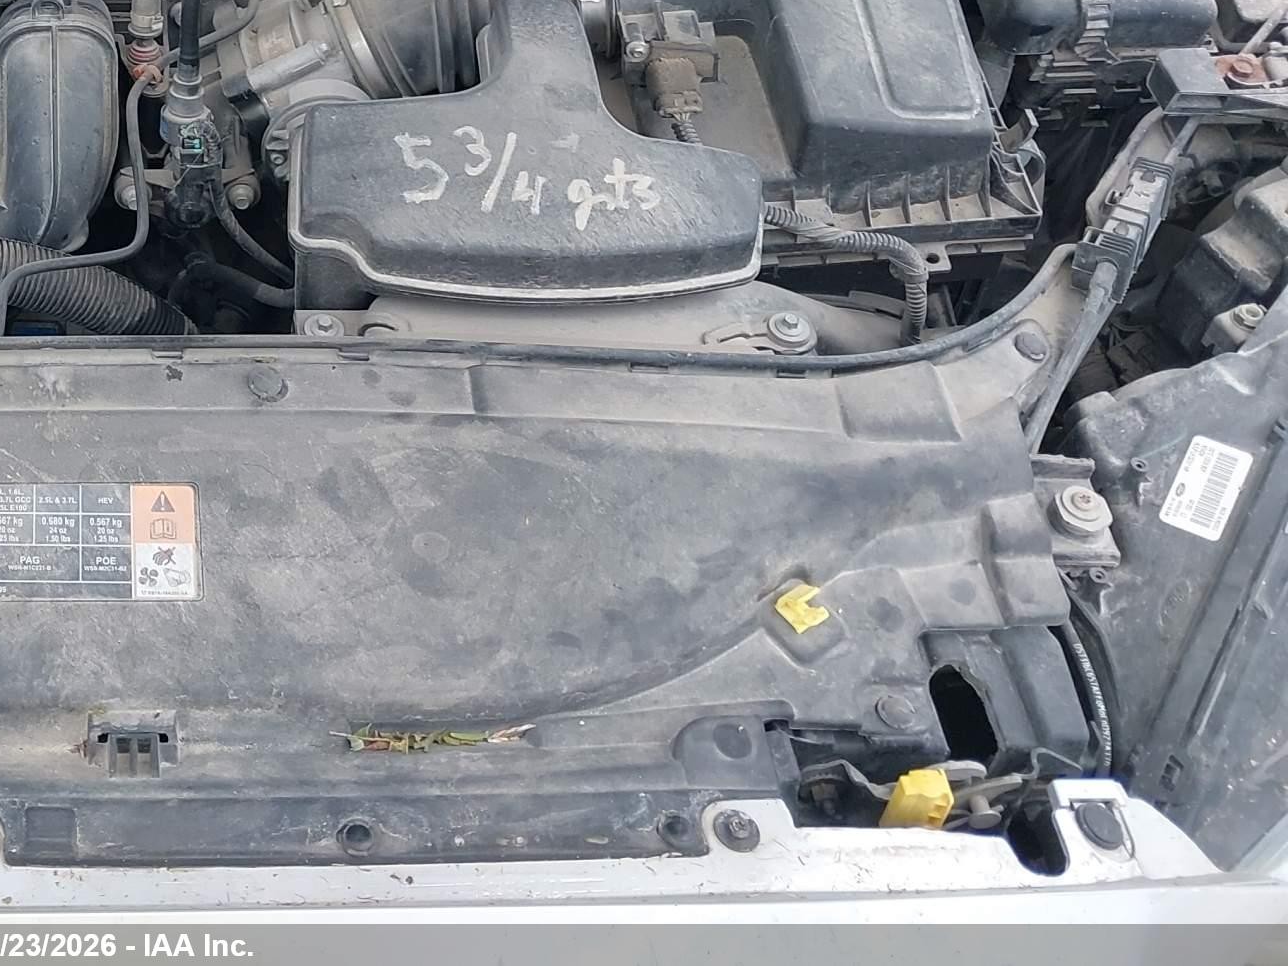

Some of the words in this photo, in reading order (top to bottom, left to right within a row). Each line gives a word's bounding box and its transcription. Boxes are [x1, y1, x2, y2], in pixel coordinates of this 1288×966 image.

[392, 131, 449, 204] 5
[97, 497, 114, 505] HEV
[13, 516, 23, 528] kg
[64, 517, 75, 528] kg
[89, 517, 110, 527] 0.567
[112, 518, 123, 529] kg
[19, 555, 41, 565] PAG
[95, 556, 117, 565] POE
